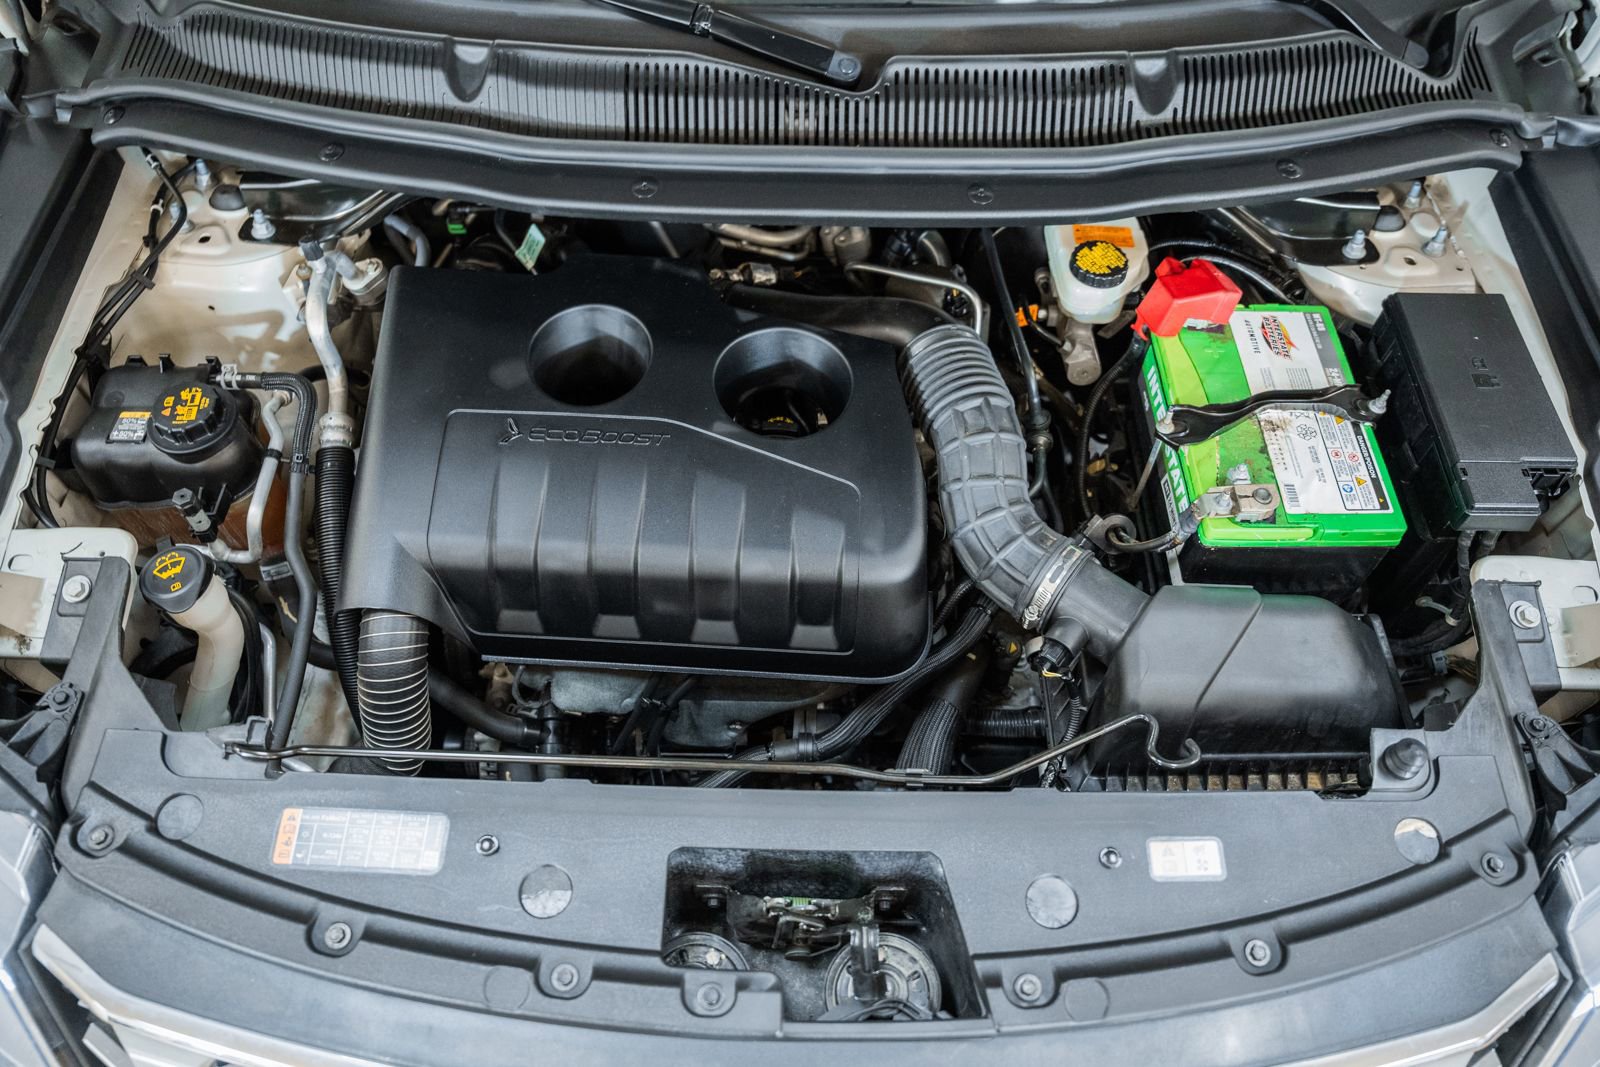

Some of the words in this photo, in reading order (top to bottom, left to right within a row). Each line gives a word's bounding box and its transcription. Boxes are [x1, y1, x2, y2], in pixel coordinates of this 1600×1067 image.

[1244, 319, 1261, 354] AUTOMOTIVE
[1263, 317, 1281, 356] BATTERIES
[1270, 315, 1291, 360] INTERSTATE
